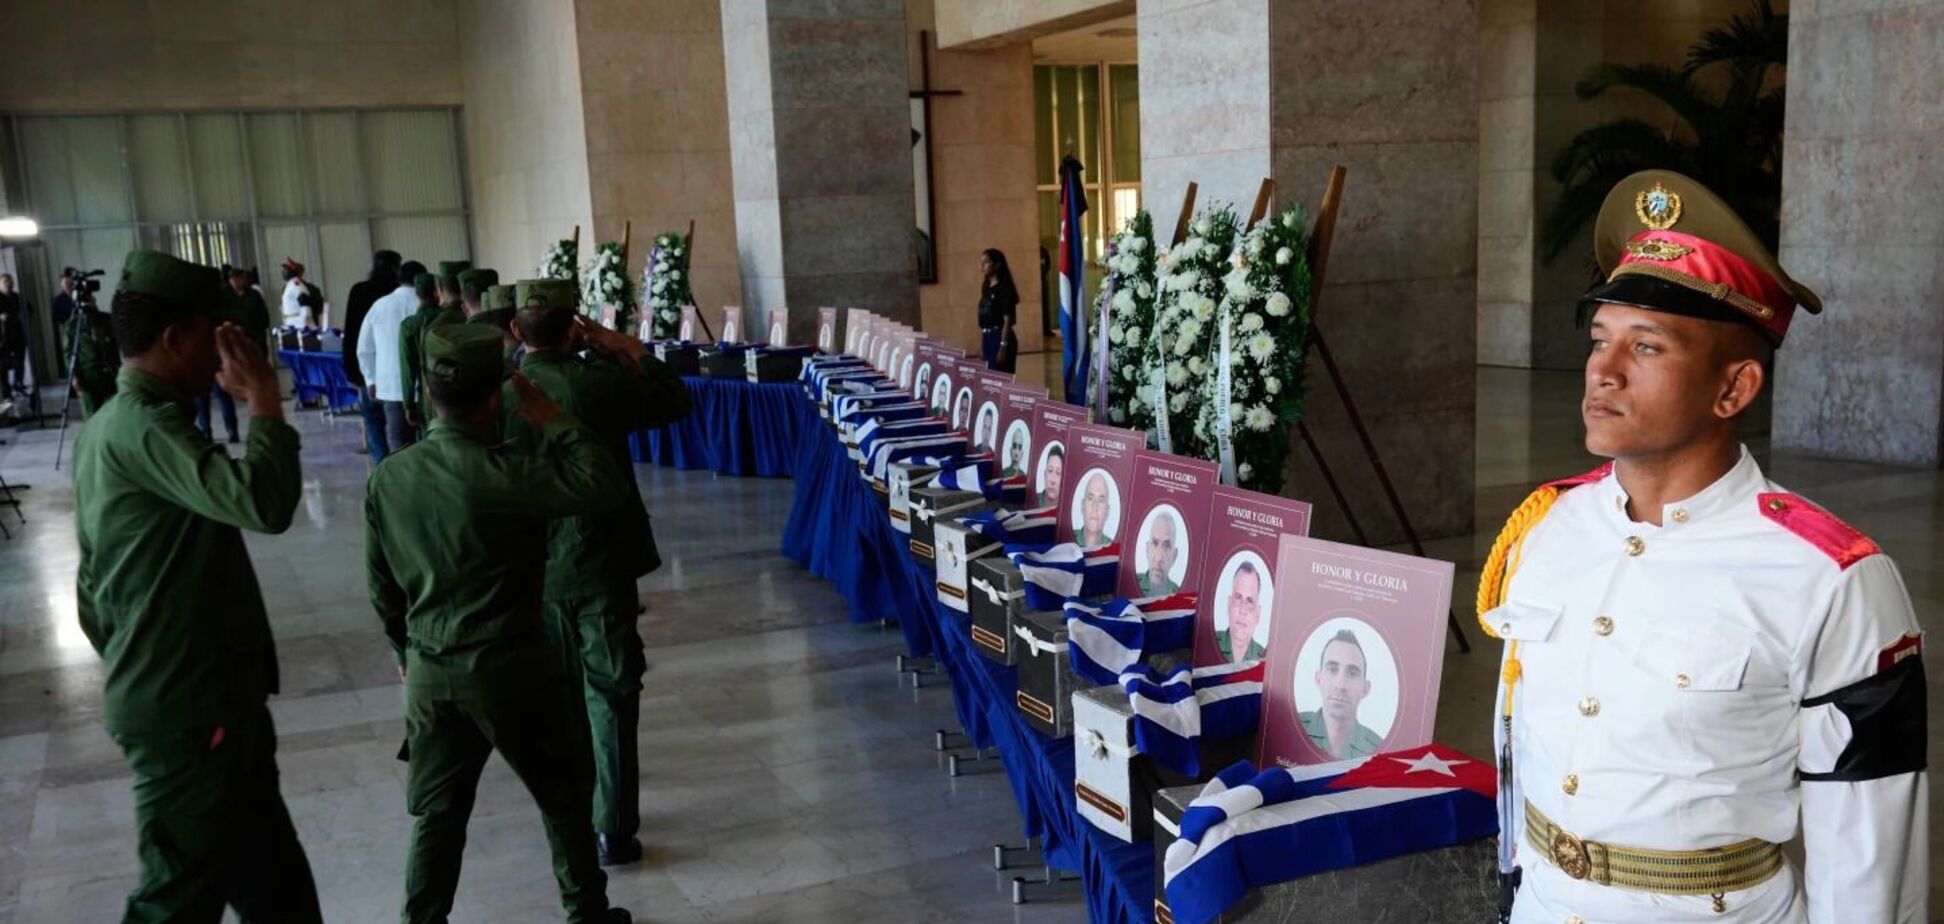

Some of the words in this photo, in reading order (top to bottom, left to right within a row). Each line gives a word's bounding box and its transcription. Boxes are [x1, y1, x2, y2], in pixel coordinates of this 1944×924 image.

[1227, 505, 1252, 520] HONOR
[1257, 512, 1284, 528] GLORIA
[1312, 561, 1352, 580] HONOR
[1354, 570, 1362, 582] Y
[1363, 572, 1408, 592] GLORIA
